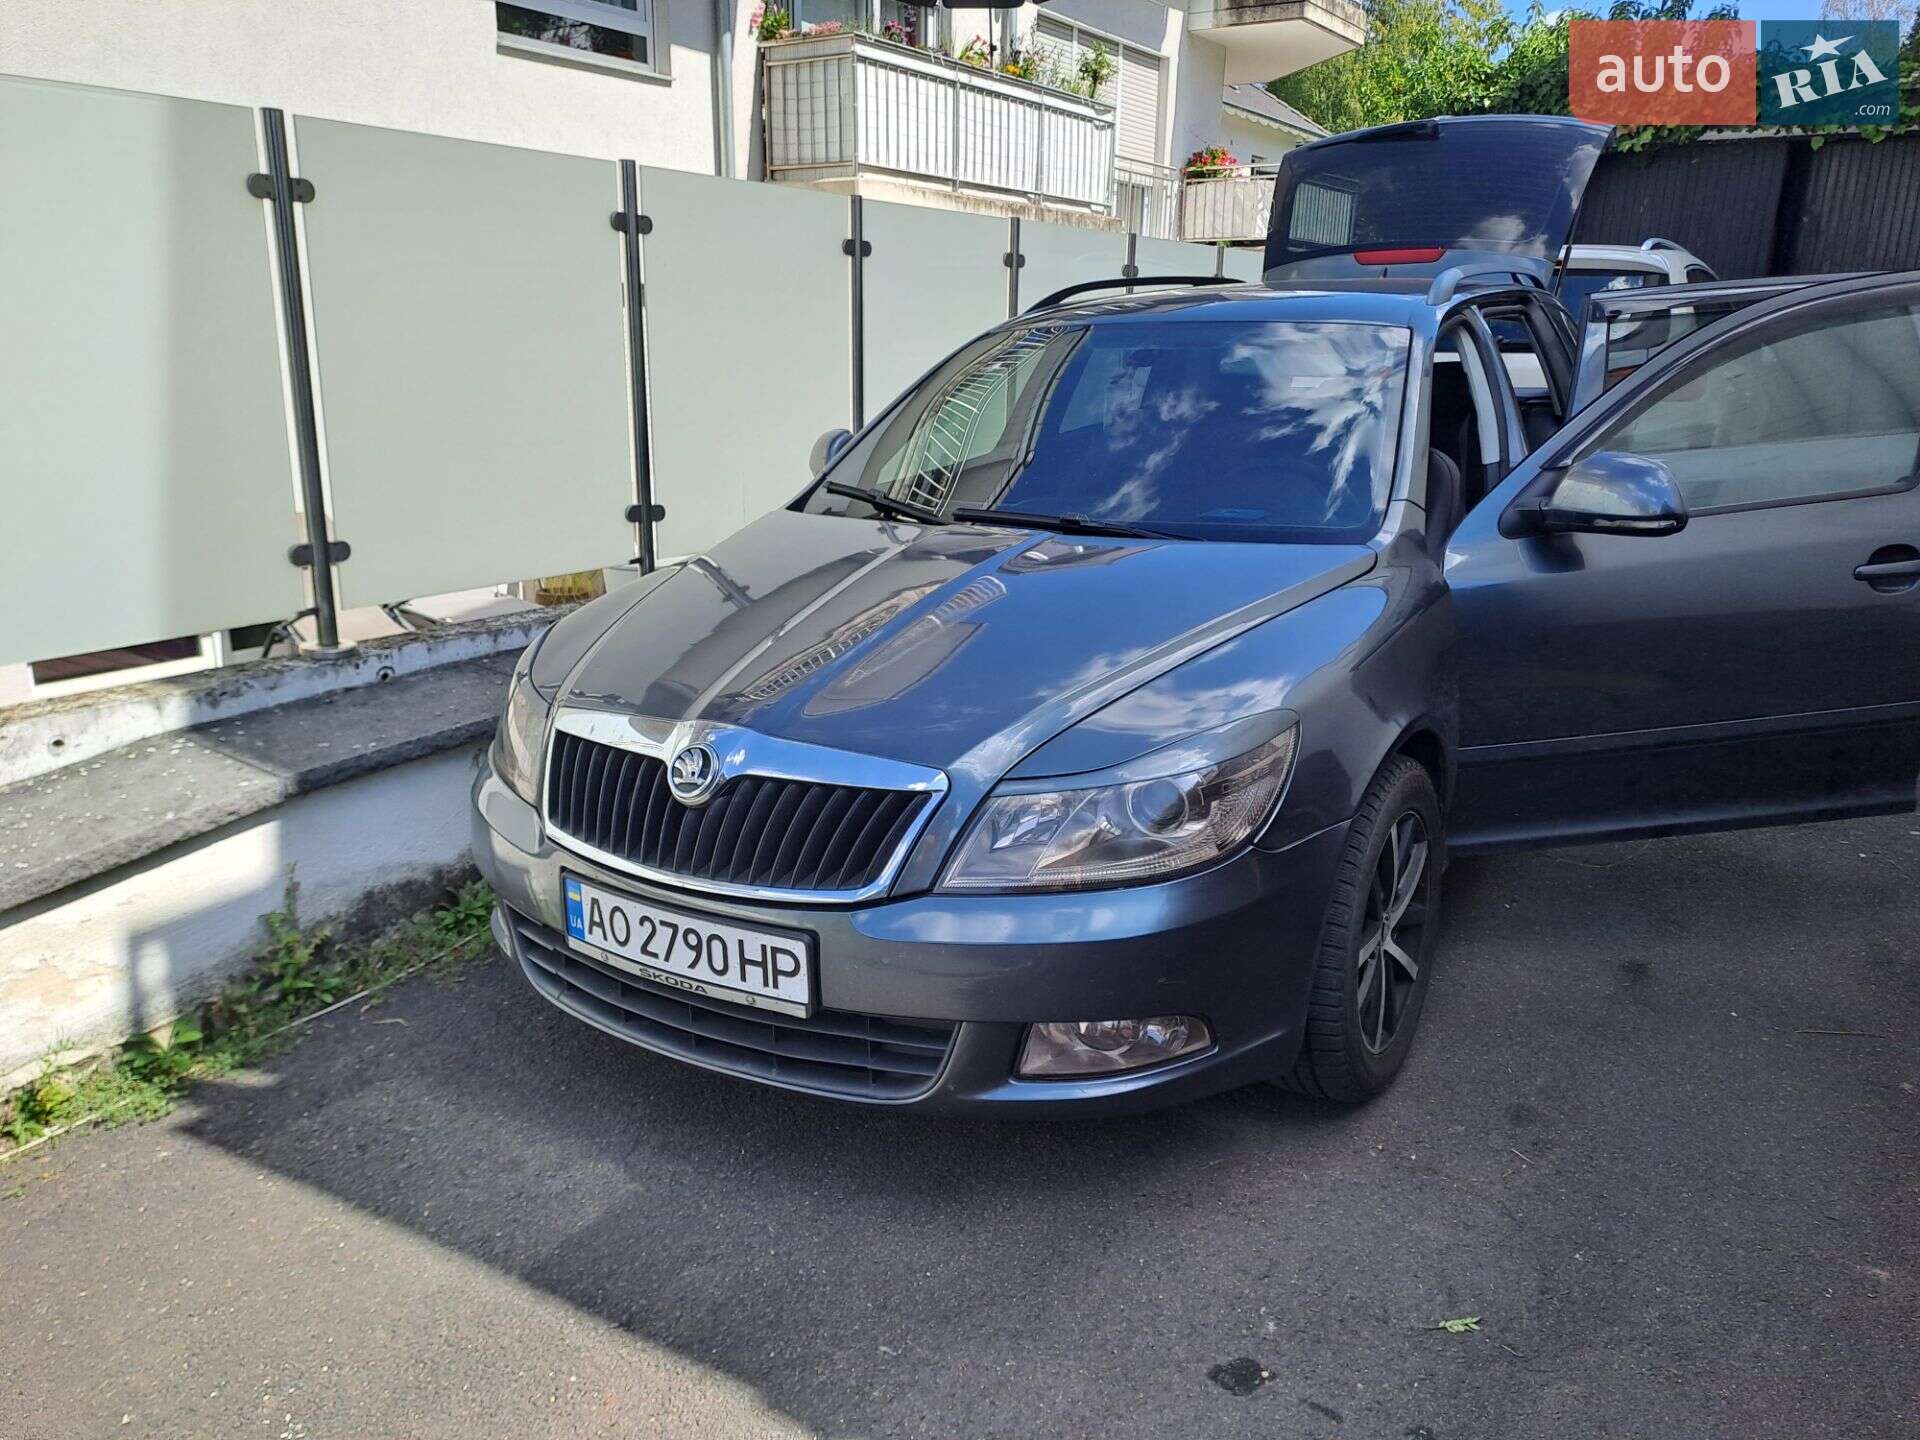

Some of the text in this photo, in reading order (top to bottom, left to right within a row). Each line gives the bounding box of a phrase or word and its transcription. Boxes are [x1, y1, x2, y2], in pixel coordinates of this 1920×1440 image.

[570, 915, 583, 930] UA
[588, 897, 801, 990] AO 2790 HP
